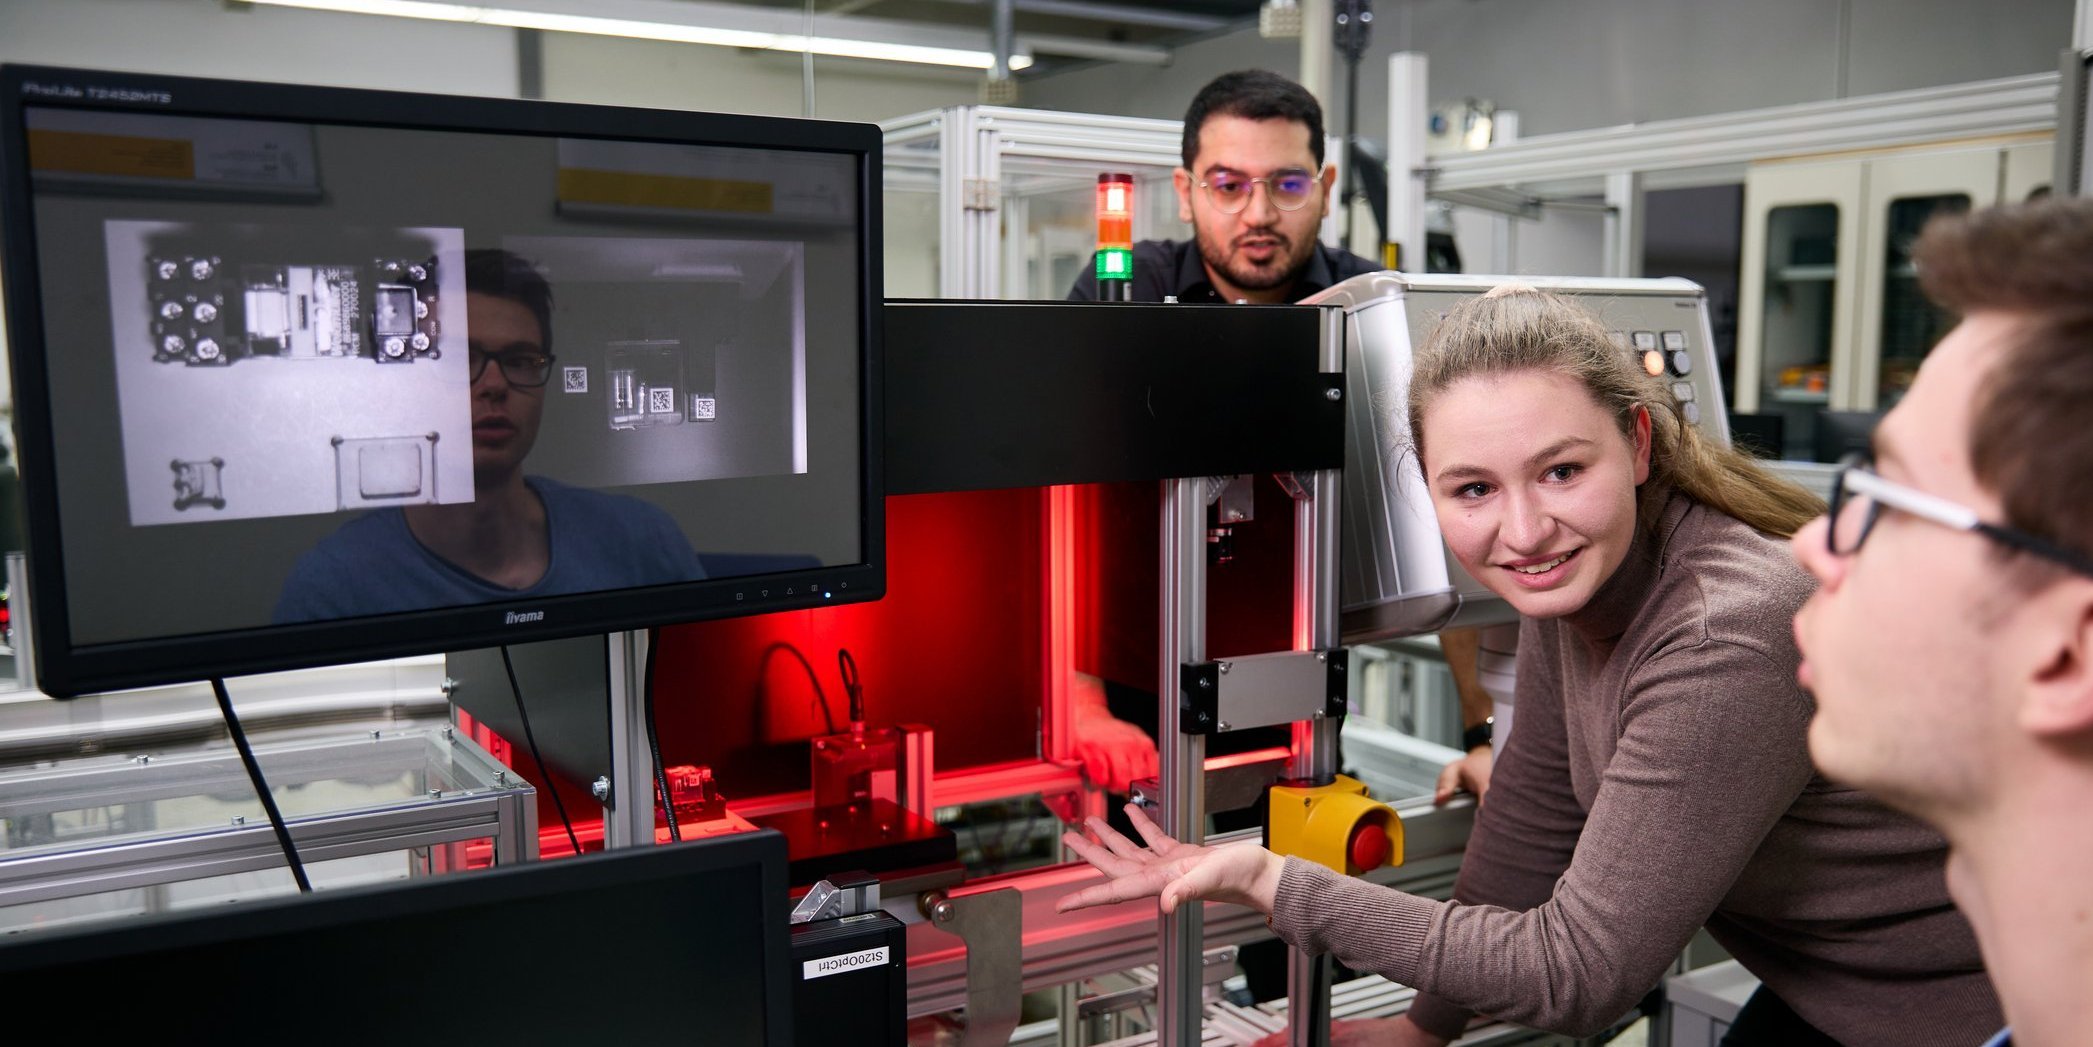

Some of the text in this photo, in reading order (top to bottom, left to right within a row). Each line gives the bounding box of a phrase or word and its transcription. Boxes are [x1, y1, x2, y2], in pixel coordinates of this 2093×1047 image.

[87, 87, 172, 104] T2452MTS
[506, 611, 545, 625] iiyama
[818, 951, 883, 972] St20OptCtrl
